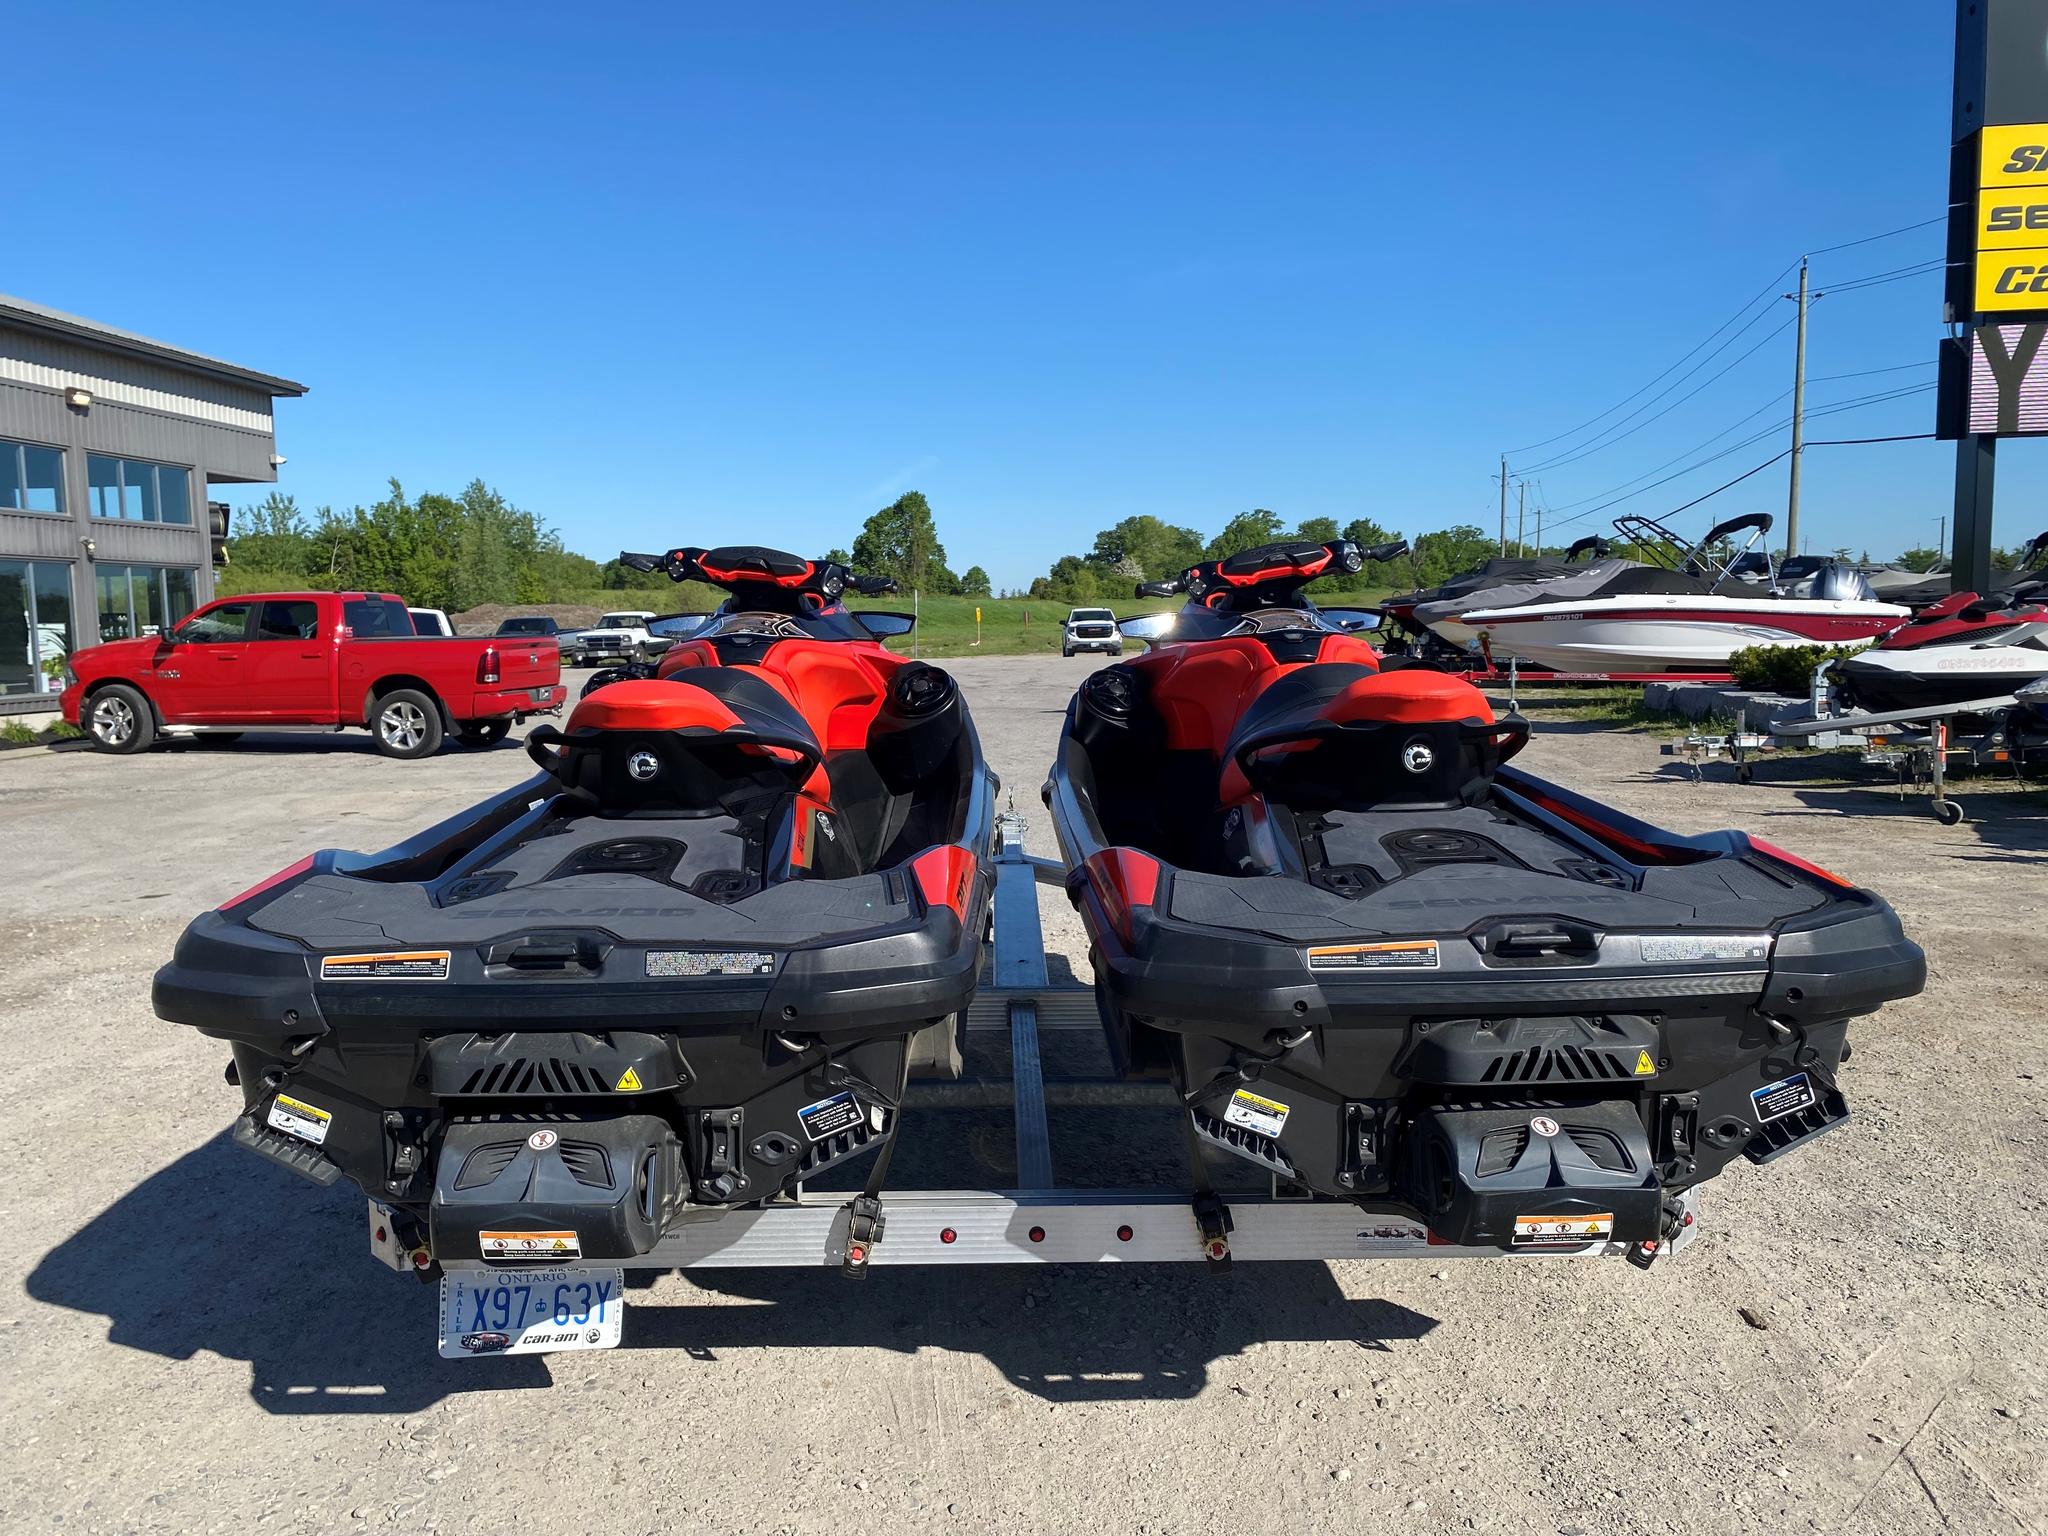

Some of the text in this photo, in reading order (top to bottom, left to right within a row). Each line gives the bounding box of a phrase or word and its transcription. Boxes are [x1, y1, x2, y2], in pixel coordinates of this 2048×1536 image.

[498, 1273, 567, 1286] ONTARIO
[472, 1280, 612, 1332] X97 63Y
[522, 1332, 579, 1345] can-am
